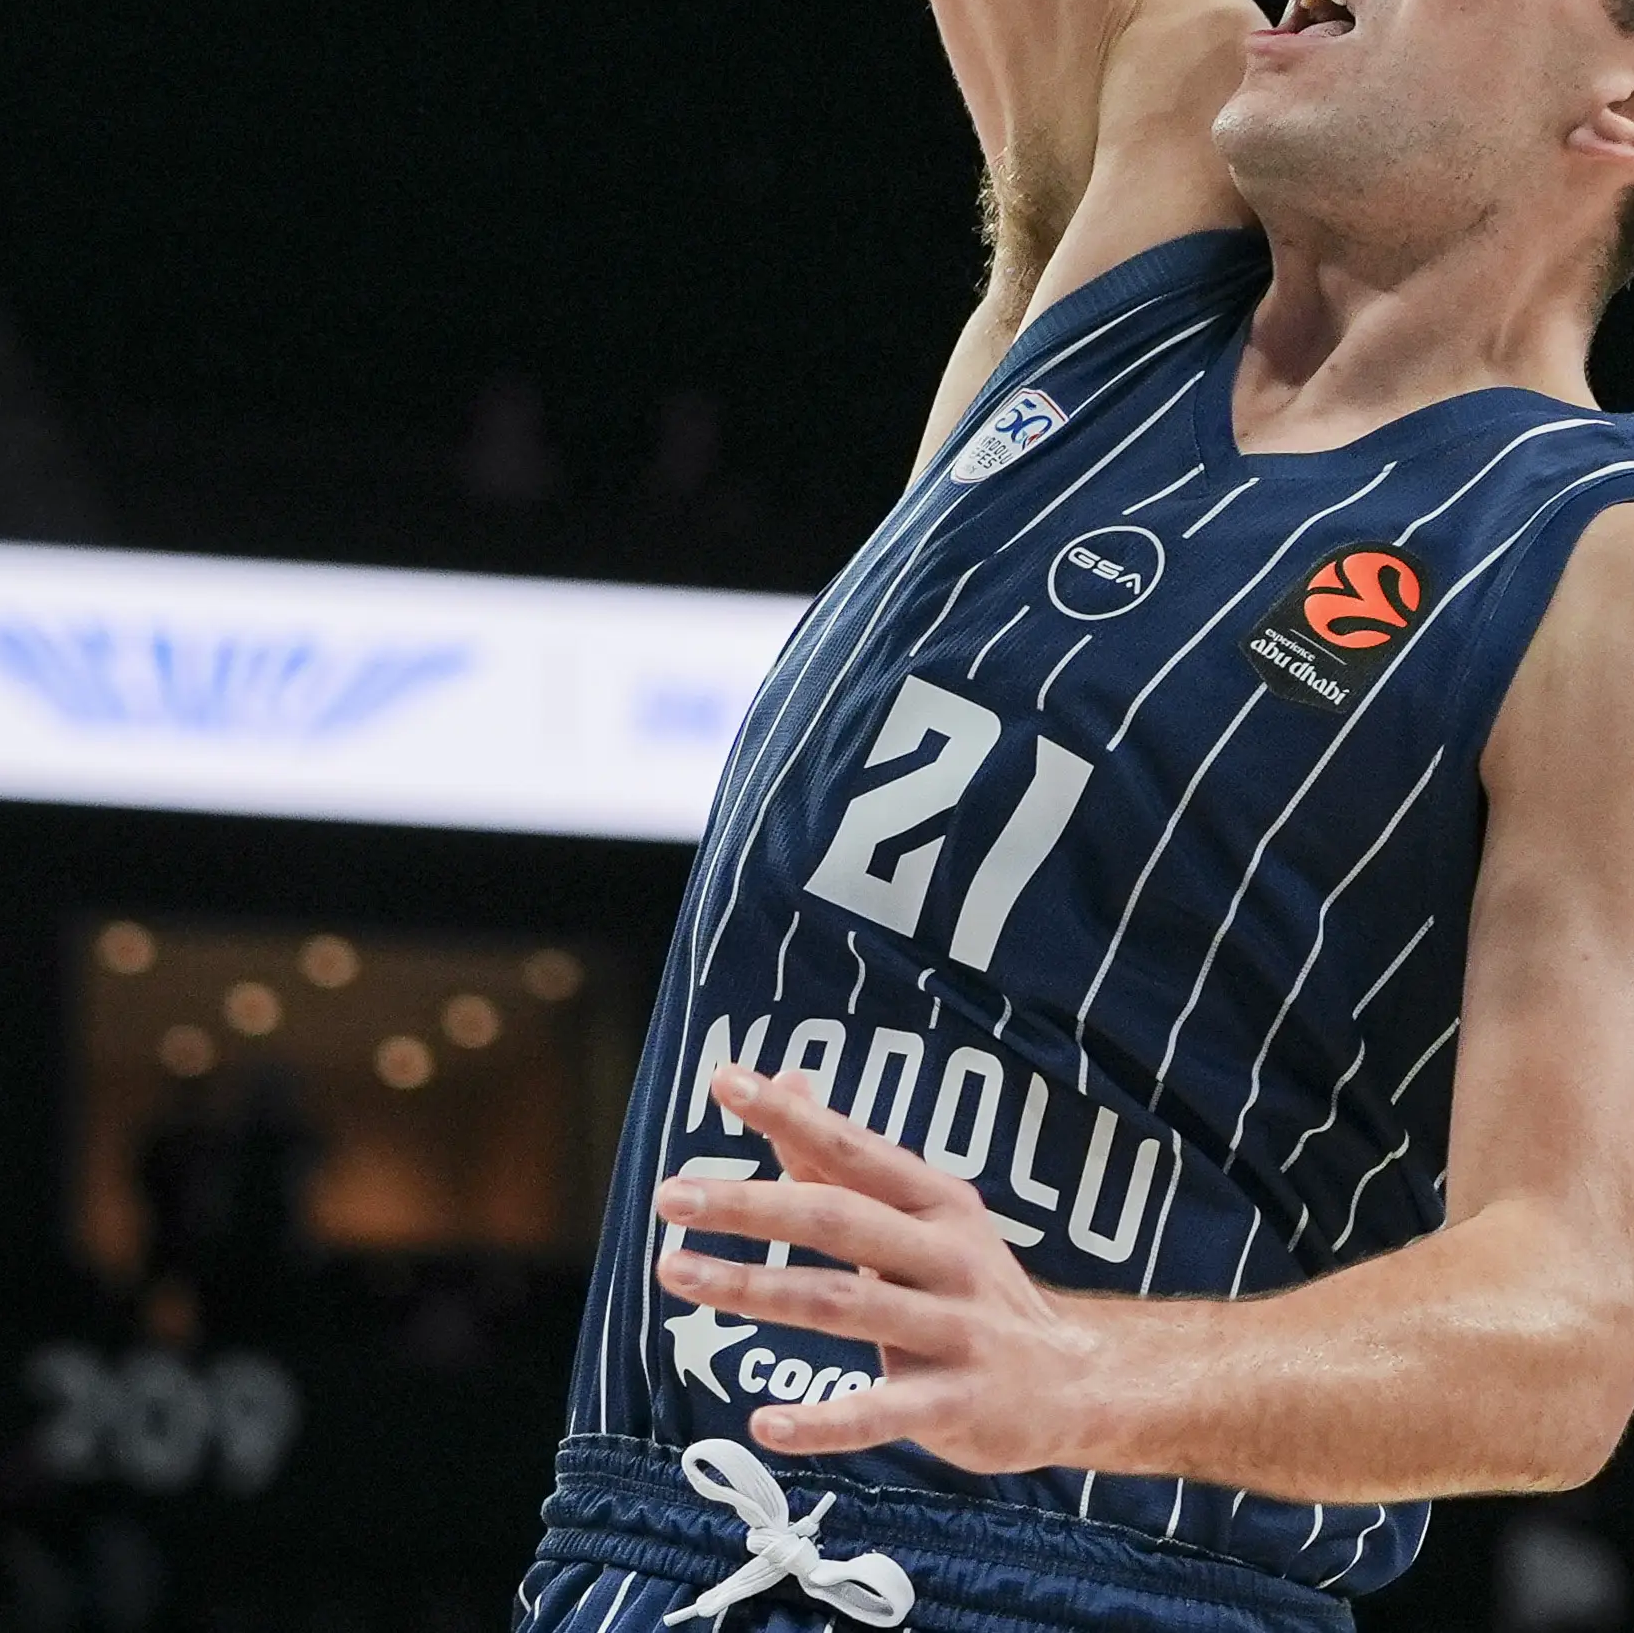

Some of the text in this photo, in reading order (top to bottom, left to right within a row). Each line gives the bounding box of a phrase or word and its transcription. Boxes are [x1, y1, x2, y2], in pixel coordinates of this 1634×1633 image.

[1068, 546, 1141, 596] GSA
[1250, 638, 1293, 669] abu
[1264, 628, 1316, 662] experience
[803, 674, 1095, 973] 21
[738, 1347, 889, 1407] core
